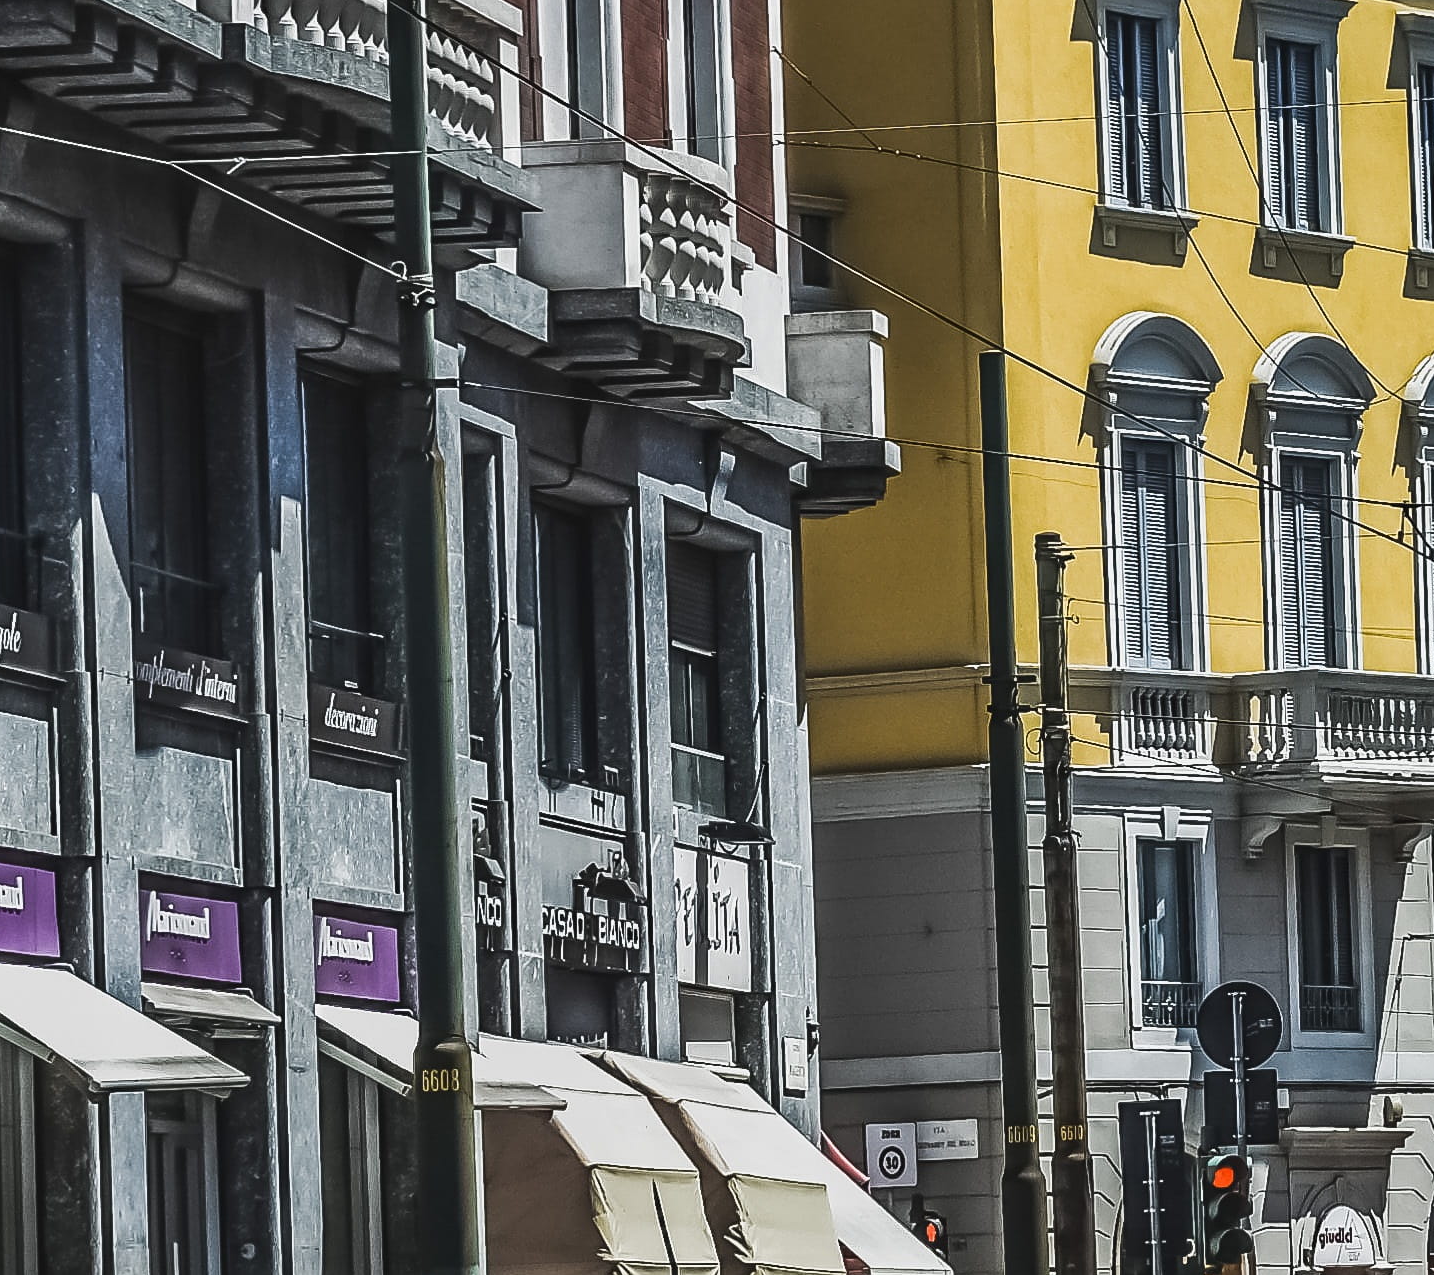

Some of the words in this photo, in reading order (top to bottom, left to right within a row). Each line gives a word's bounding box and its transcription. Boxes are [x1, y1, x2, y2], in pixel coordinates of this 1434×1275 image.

[477, 897, 502, 927] NCO
[598, 915, 640, 950] BIANCO
[422, 1068, 460, 1092] 6608
